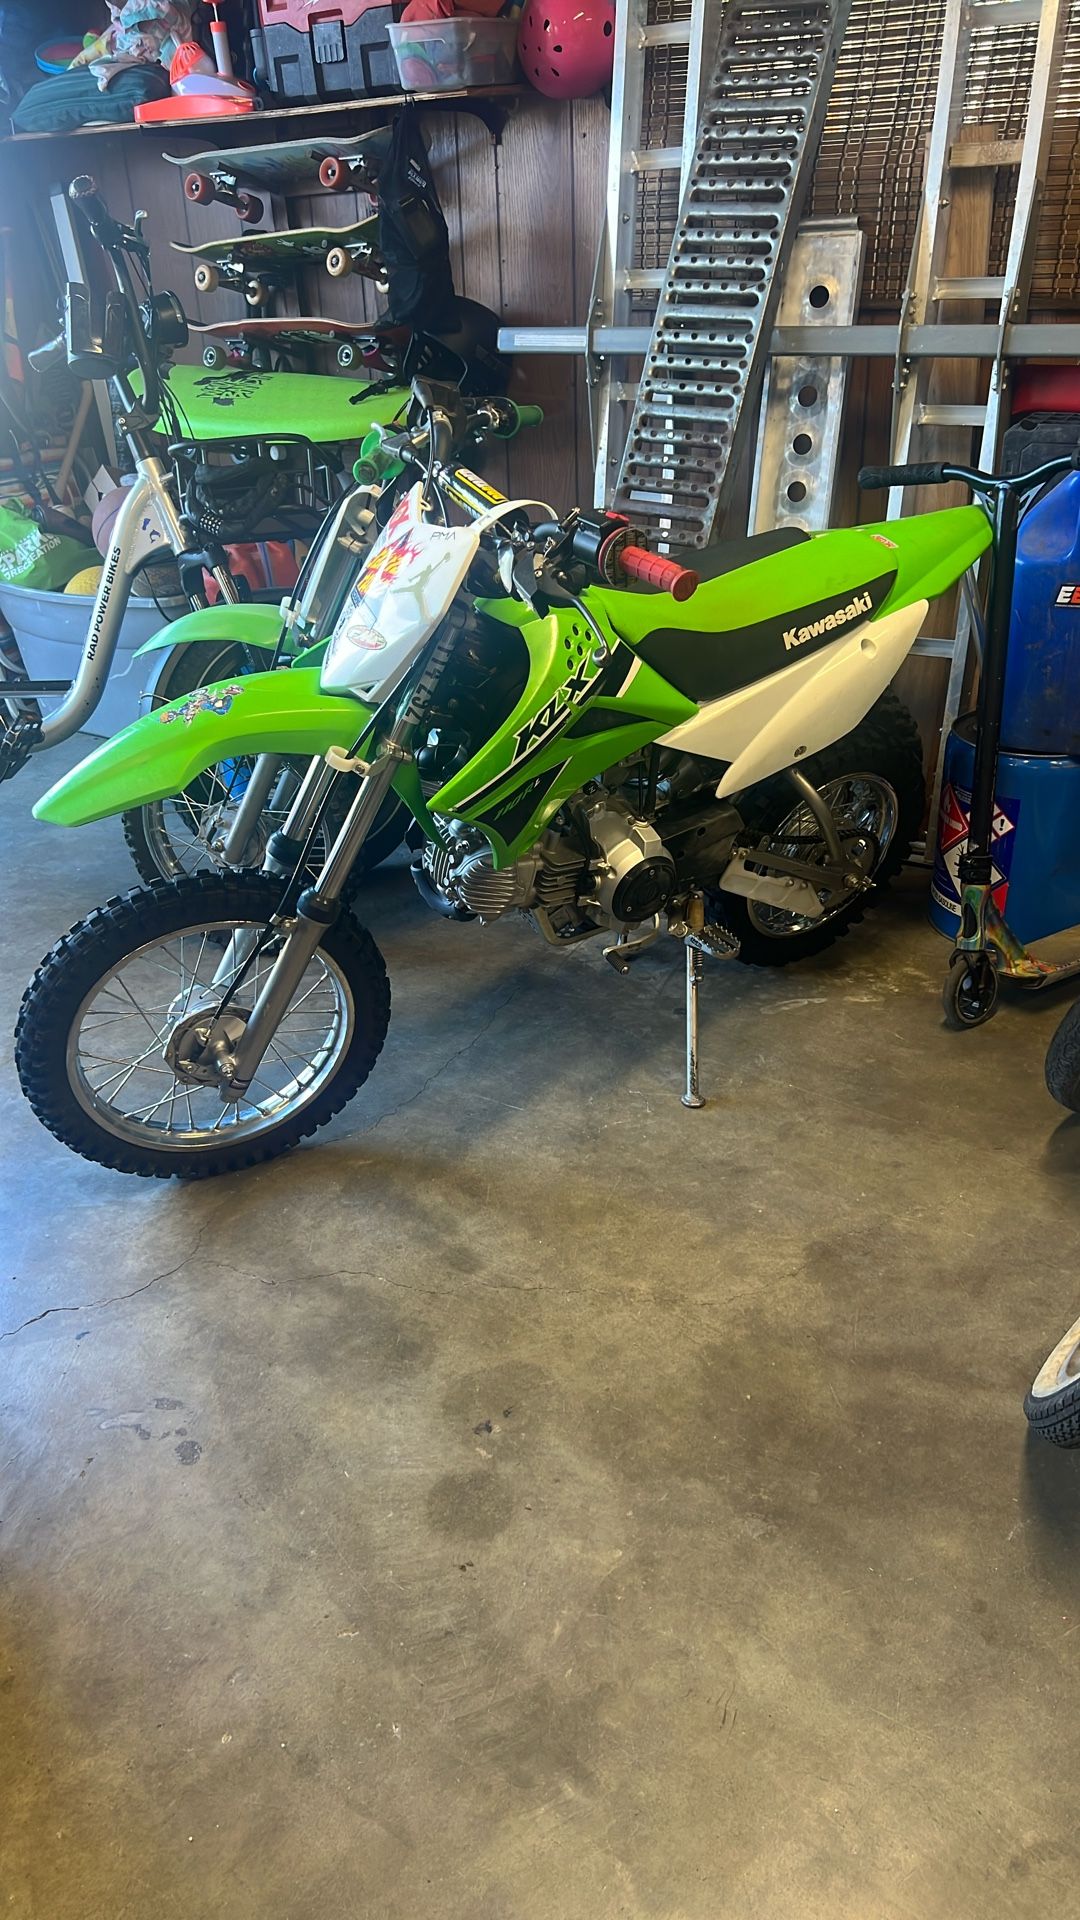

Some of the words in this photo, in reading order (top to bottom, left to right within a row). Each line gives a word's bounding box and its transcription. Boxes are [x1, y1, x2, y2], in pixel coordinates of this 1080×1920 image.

[87, 634, 99, 661] RAD
[94, 587, 112, 632] POWER
[106, 546, 121, 586] BIKES
[782, 591, 873, 651] Kawasaki
